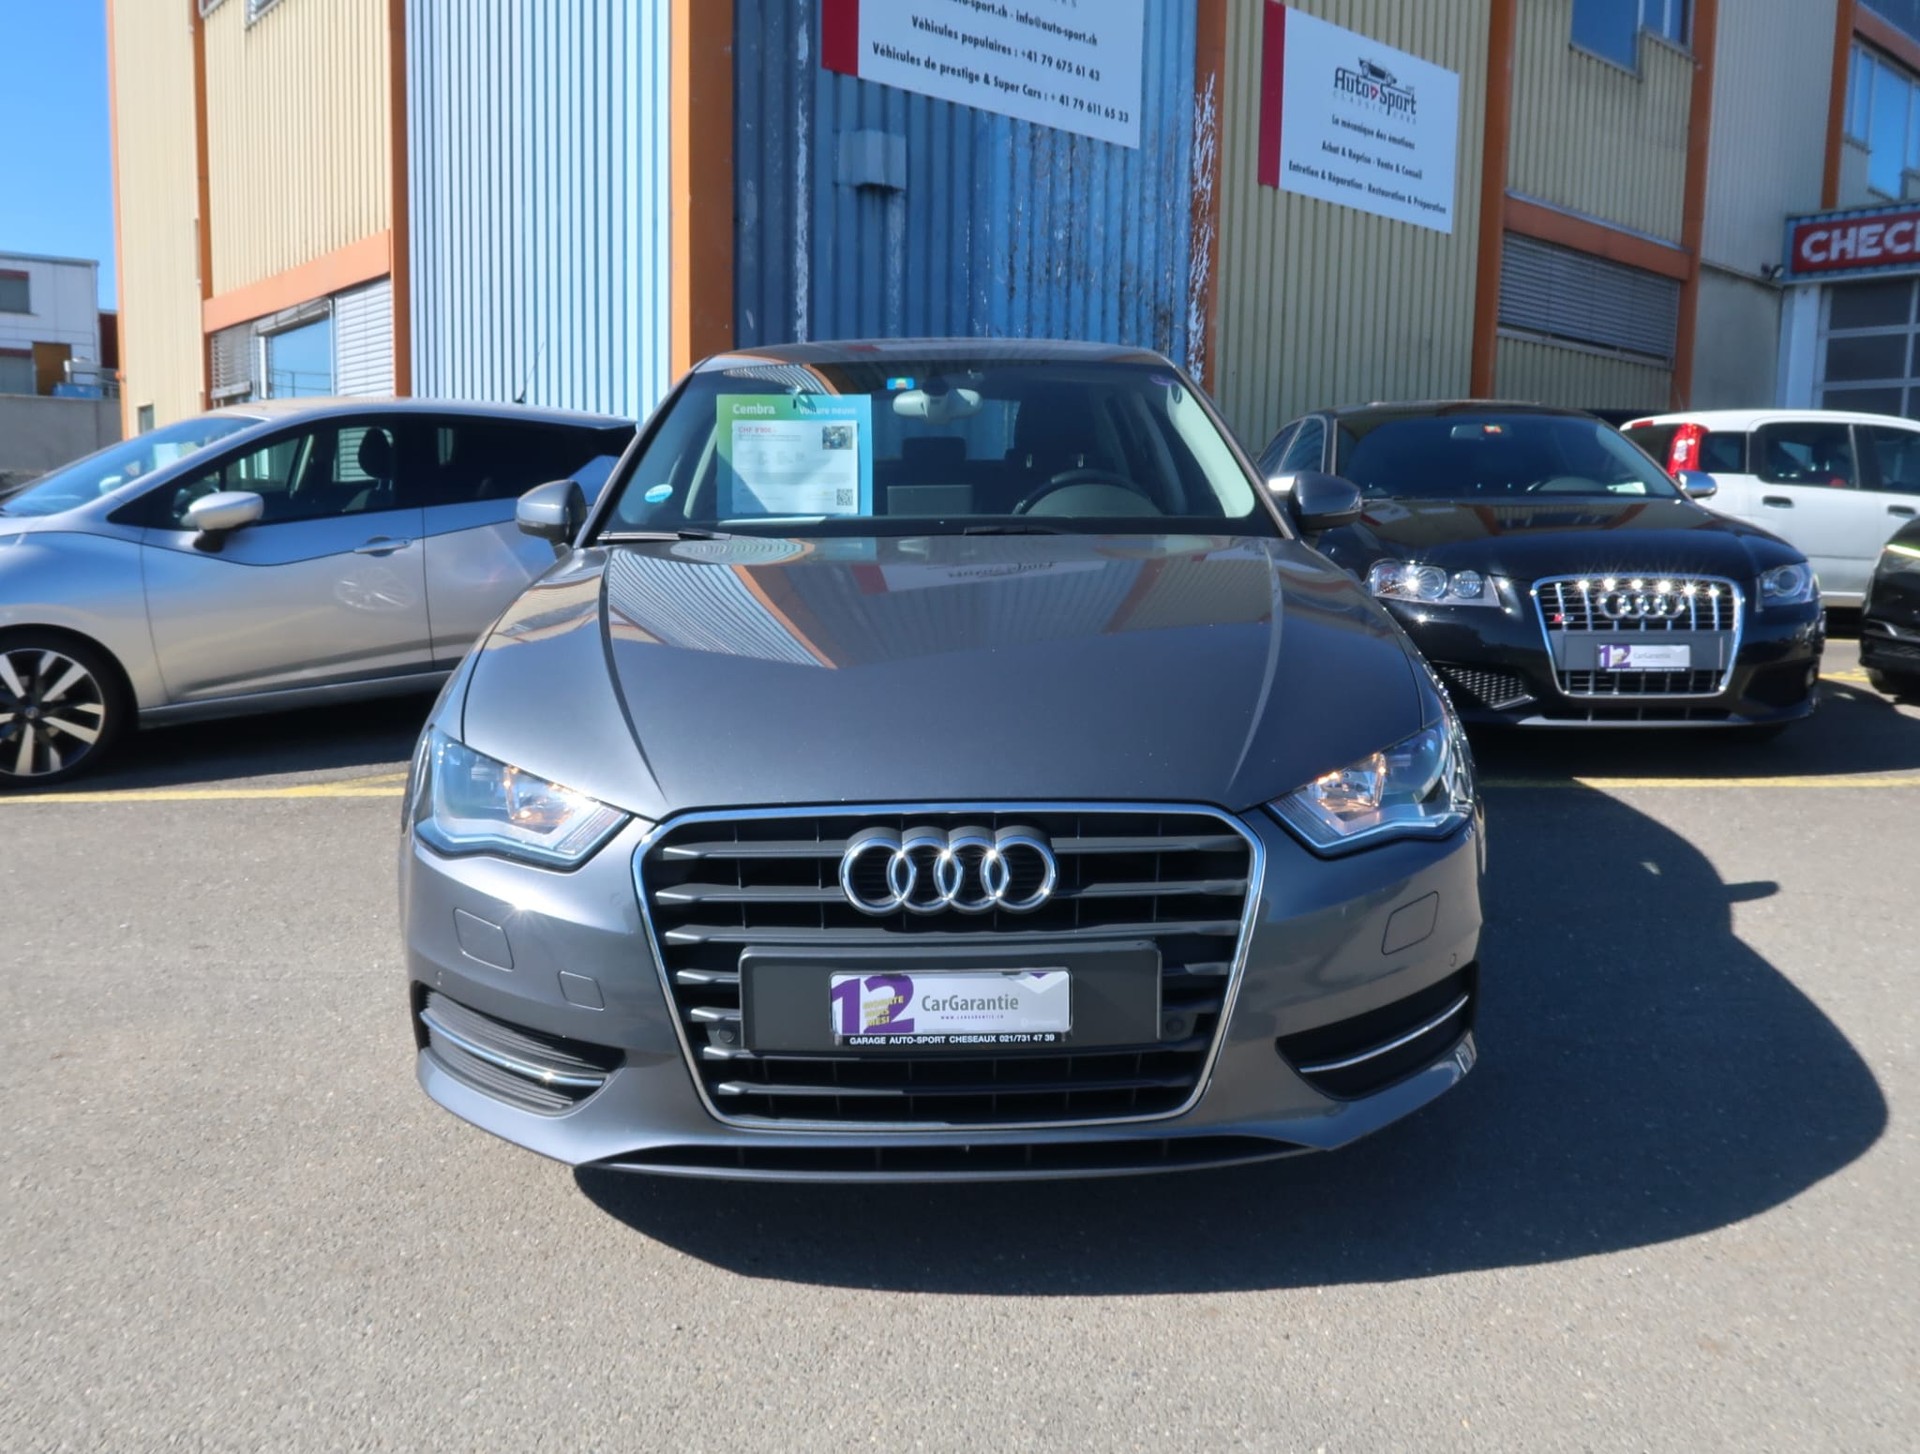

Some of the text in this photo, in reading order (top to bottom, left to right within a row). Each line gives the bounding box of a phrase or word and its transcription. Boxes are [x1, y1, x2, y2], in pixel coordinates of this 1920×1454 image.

[1016, 9, 1098, 46] info@auto-sport.ch
[911, 15, 958, 39] Véhicules
[961, 33, 1012, 56] populaires
[1041, 54, 1053, 68] 79
[1056, 59, 1073, 73] 675
[1076, 64, 1086, 77] 61
[1088, 69, 1100, 82] 43
[872, 41, 921, 66] Véhicules
[924, 56, 937, 71] de
[940, 63, 980, 84] prestige
[983, 72, 991, 85] &
[994, 75, 1020, 93] Super
[1022, 84, 1042, 100] Cars
[1059, 94, 1070, 108] 41
[1073, 98, 1085, 111] 79
[1087, 102, 1101, 116] 611
[1104, 107, 1116, 119] 65
[1118, 111, 1130, 124] 33
[732, 404, 776, 415] Cembra
[1600, 644, 1631, 668] 12
[832, 975, 915, 1034] 12
[921, 994, 1019, 1012] CarGarantie
[849, 1036, 886, 1045] GARAGE
[889, 1035, 946, 1045] AUTO-SPORT
[949, 1035, 996, 1044] CHESEAUX
[999, 1034, 1031, 1043] 021/731
[1033, 1034, 1043, 1042] 47
